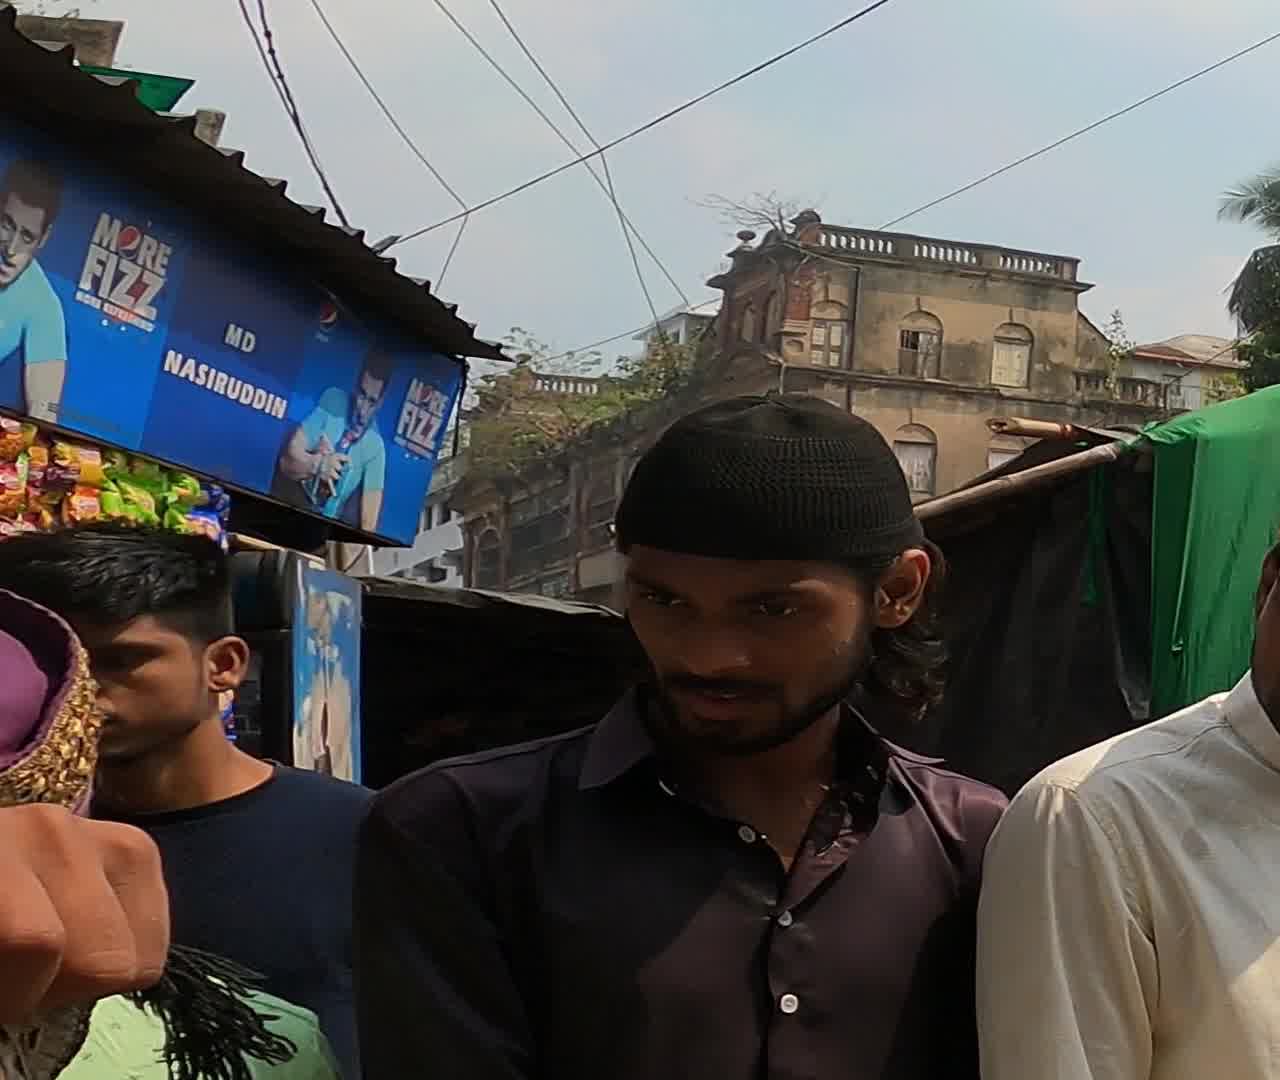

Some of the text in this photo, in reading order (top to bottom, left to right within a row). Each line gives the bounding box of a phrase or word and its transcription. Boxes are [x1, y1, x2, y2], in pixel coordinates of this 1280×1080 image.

[93, 213, 172, 275] MORE
[79, 244, 167, 320] FIZZ
[225, 324, 256, 352] MD
[163, 350, 288, 419] NASIRUDDIN
[396, 401, 442, 451] FIZZ
